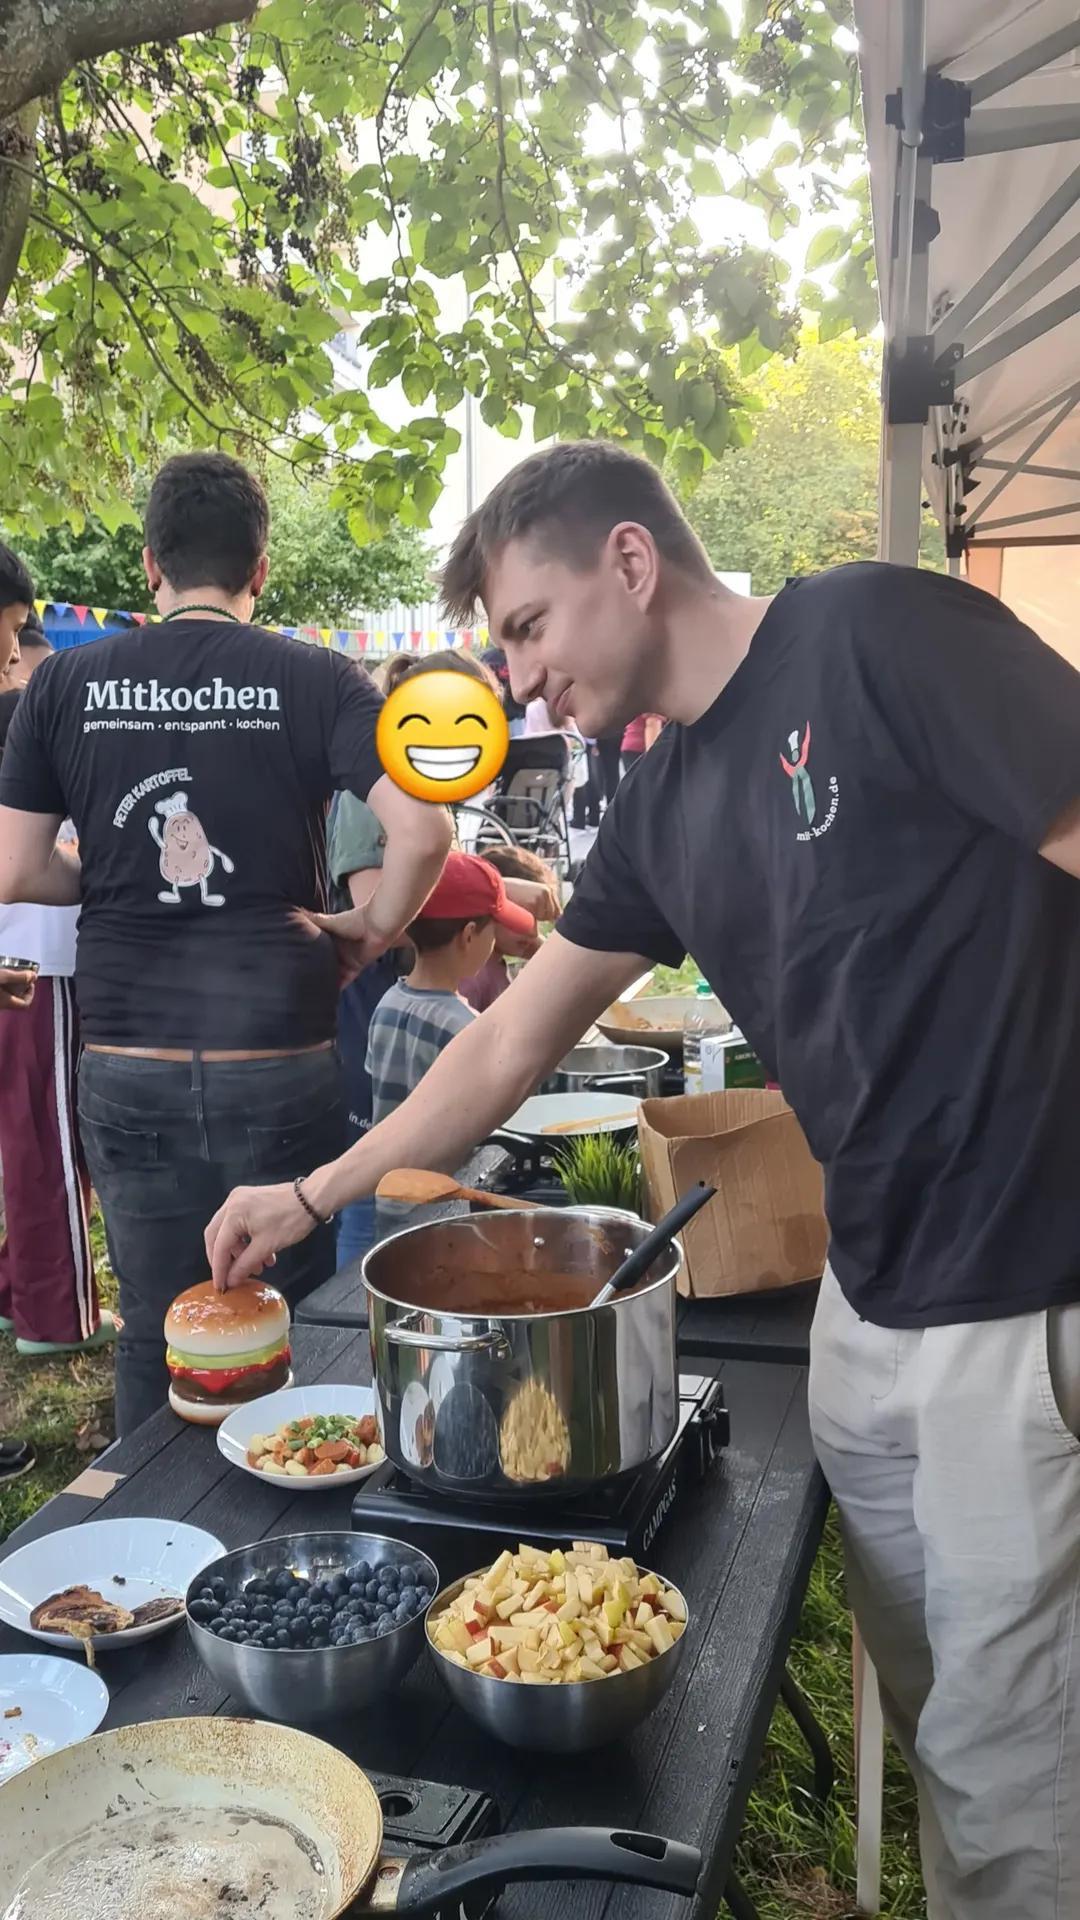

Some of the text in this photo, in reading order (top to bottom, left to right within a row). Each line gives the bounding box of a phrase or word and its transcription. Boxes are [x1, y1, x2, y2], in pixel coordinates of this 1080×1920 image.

[84, 677, 280, 711] Mitkochen
[83, 718, 280, 733] gemeinsam entspannt kochen
[113, 768, 193, 829] PETER KARTOFFEL
